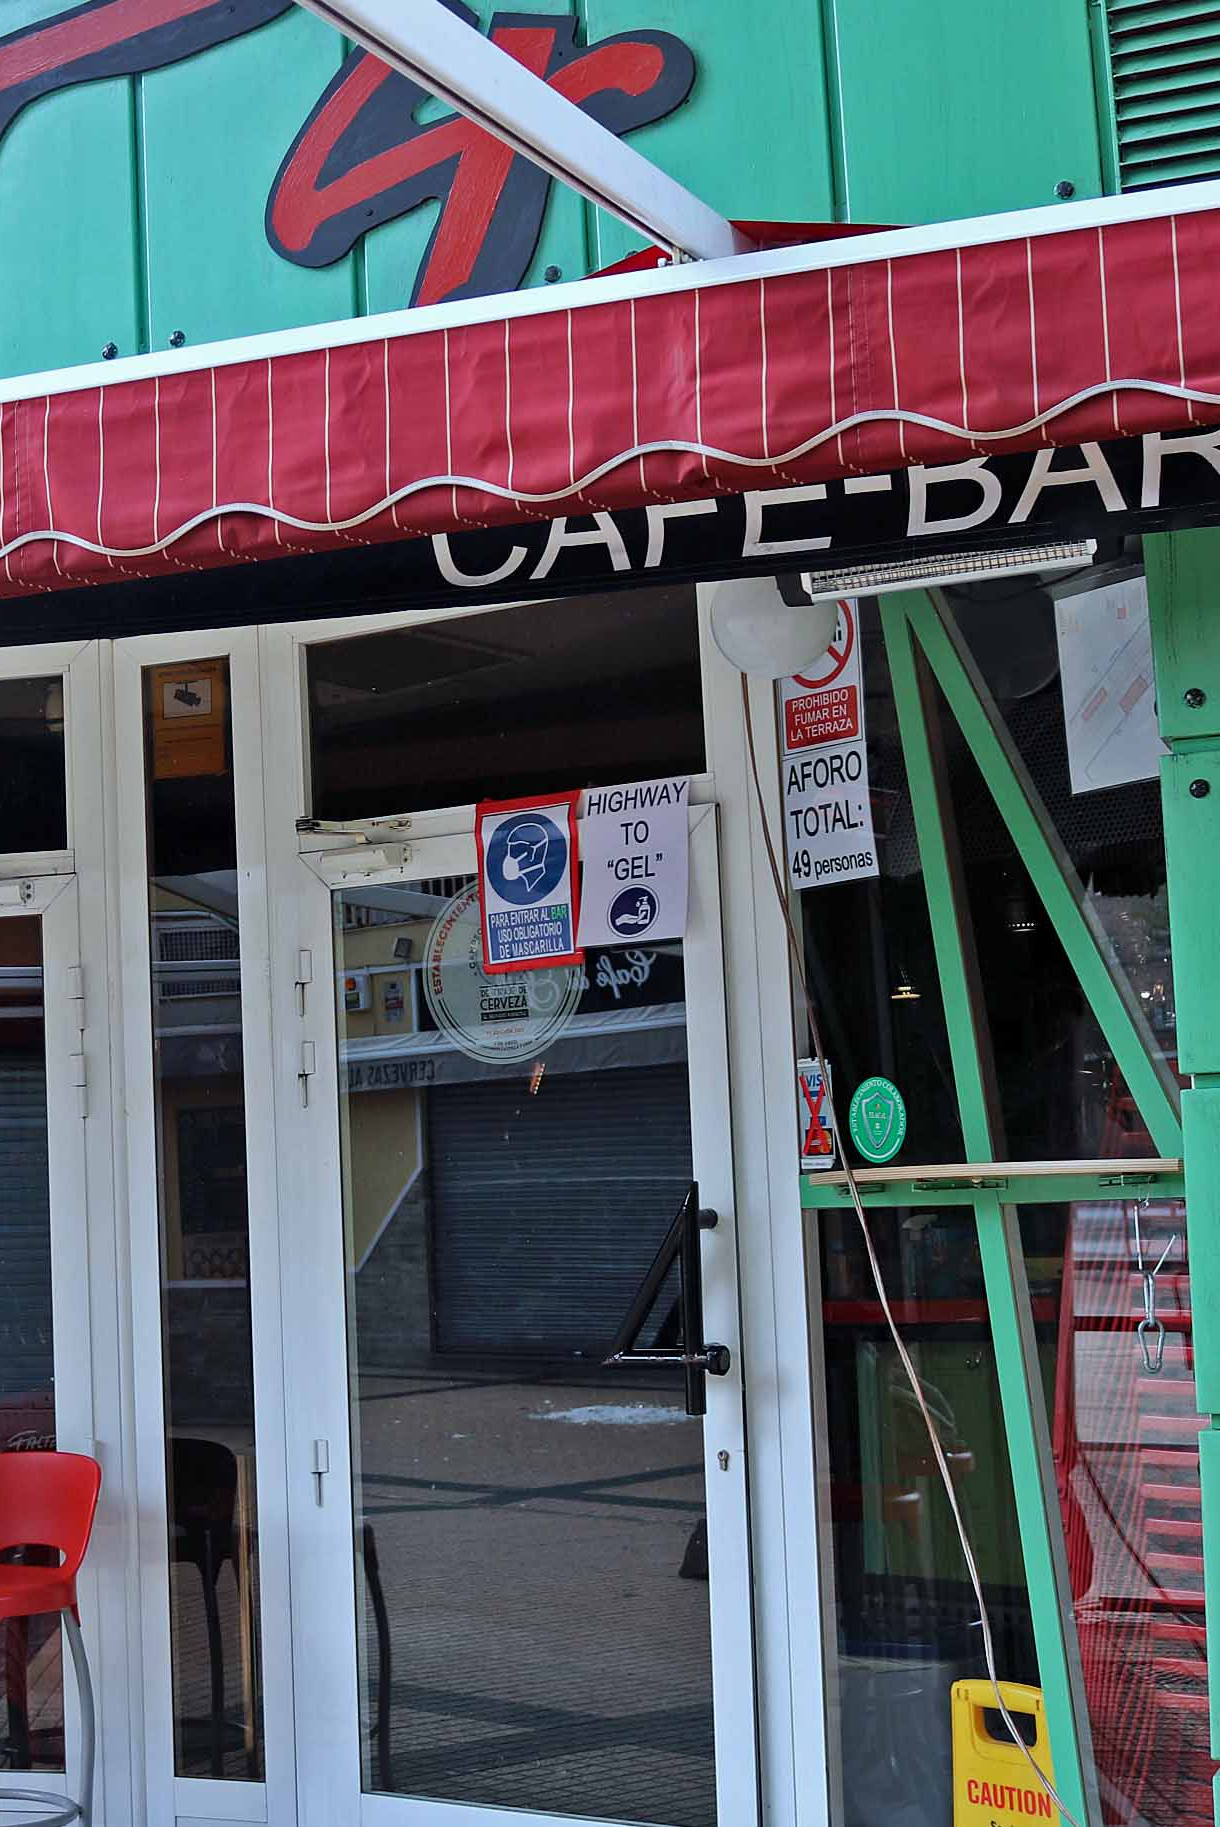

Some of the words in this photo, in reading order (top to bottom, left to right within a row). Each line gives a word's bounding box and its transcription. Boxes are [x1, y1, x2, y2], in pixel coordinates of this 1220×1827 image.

[792, 688, 848, 713] PROHIBIDO
[794, 707, 830, 726] FUMAR
[832, 704, 847, 716] EN
[790, 729, 803, 742] LA
[805, 718, 853, 738] TERRAZA
[787, 750, 862, 795] AFORO
[587, 780, 687, 817] HIGHWAY
[790, 799, 864, 840] TOTAL:
[620, 820, 649, 846] TO
[792, 849, 811, 879] 49
[814, 850, 873, 881] personas
[490, 913, 510, 928] PARA
[510, 910, 540, 925] ENTRAR
[540, 909, 550, 922] AL
[550, 906, 568, 920] BAR
[497, 929, 513, 943] USO
[513, 923, 563, 941] OBLIGATORIO
[499, 944, 511, 958] DE
[512, 937, 565, 957] MASCARILLA
[480, 994, 529, 1011] CERVEZA
[967, 1778, 1053, 1819] CAUTION
